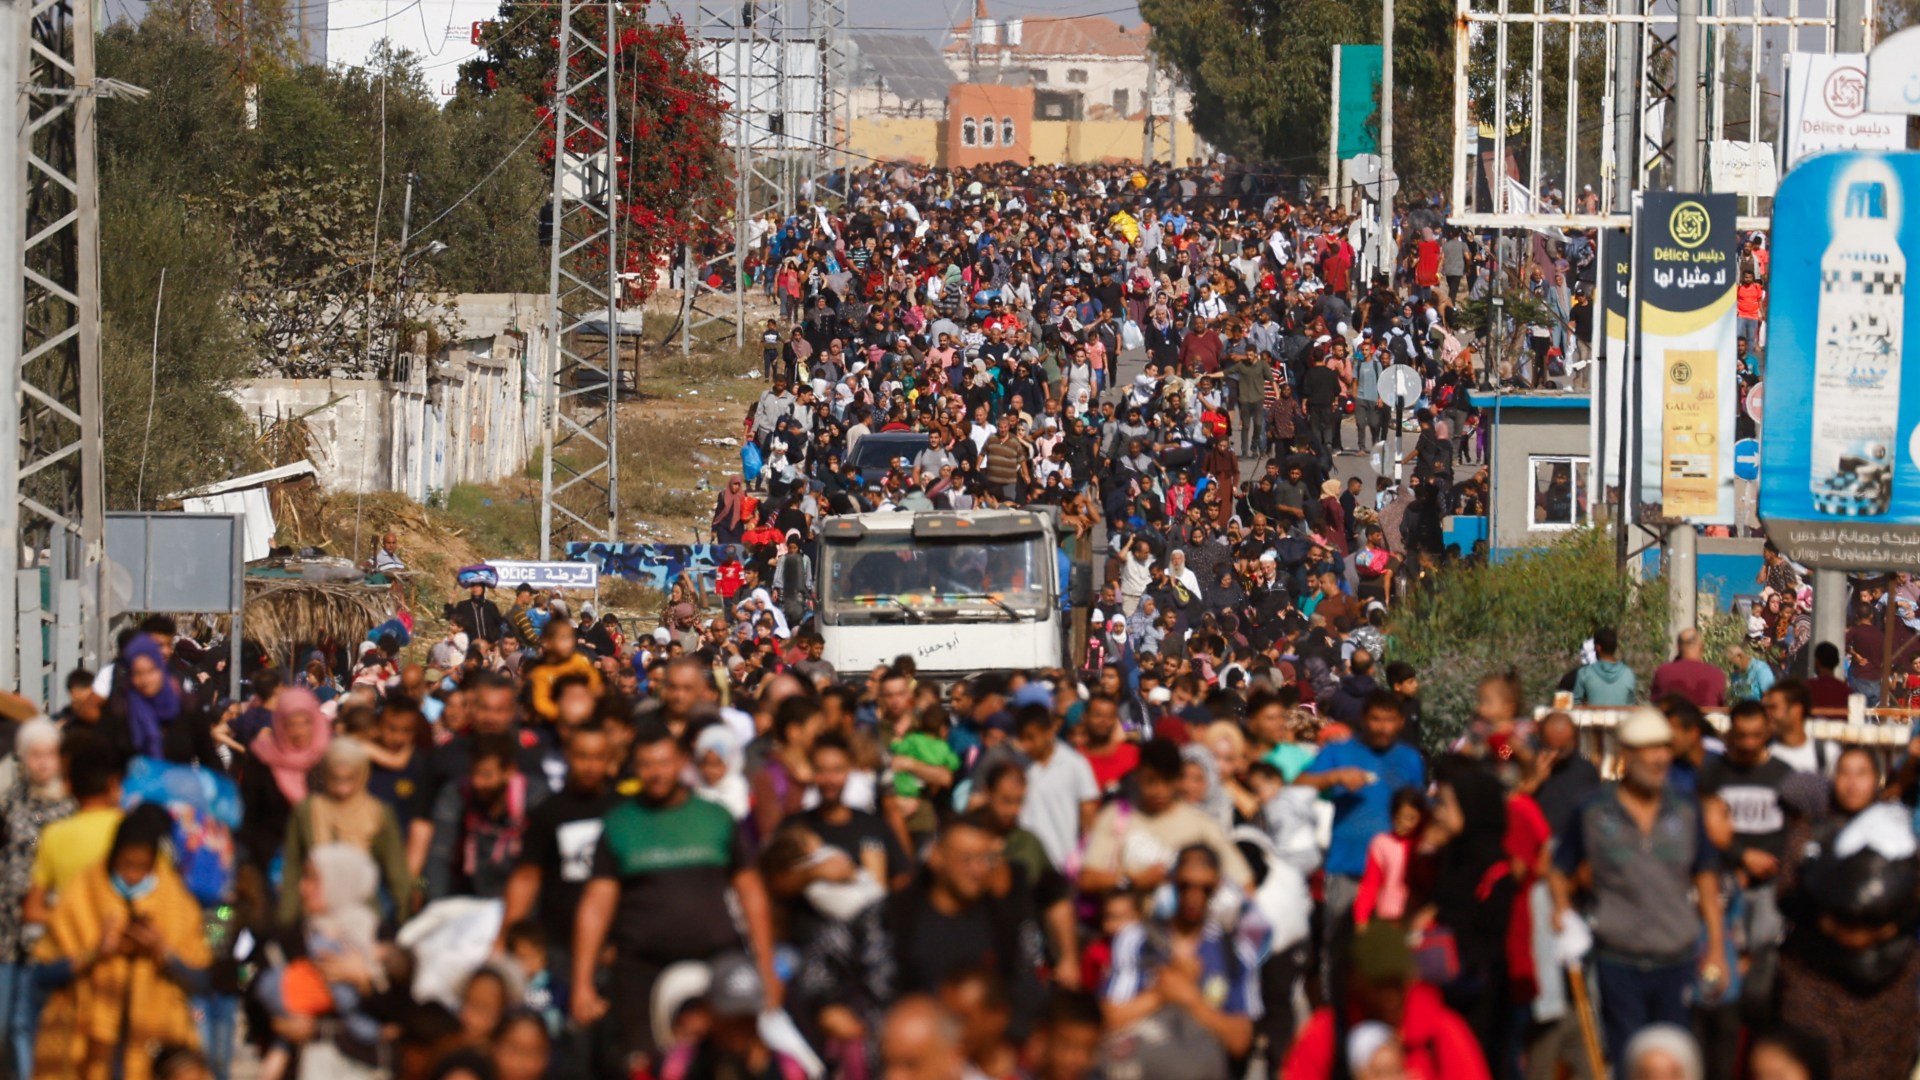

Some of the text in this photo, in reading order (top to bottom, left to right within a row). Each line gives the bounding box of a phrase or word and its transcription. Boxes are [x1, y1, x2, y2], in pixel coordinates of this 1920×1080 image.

[1802, 119, 1845, 135] Délice
[1849, 121, 1890, 137] ديليس
[1653, 246, 1690, 261] Délice
[1692, 248, 1726, 264] ديليس
[1653, 267, 1674, 288] لها
[1677, 265, 1711, 288] مثيل
[1713, 267, 1726, 285] لا
[1616, 280, 1628, 298] ها
[1790, 528, 1836, 545] القدس
[1837, 528, 1880, 546] مصانع
[1832, 546, 1890, 562] الكيماوية
[499, 567, 536, 580] OLICE
[544, 567, 588, 583] شرطة
[917, 631, 960, 658] أبو حمزة
